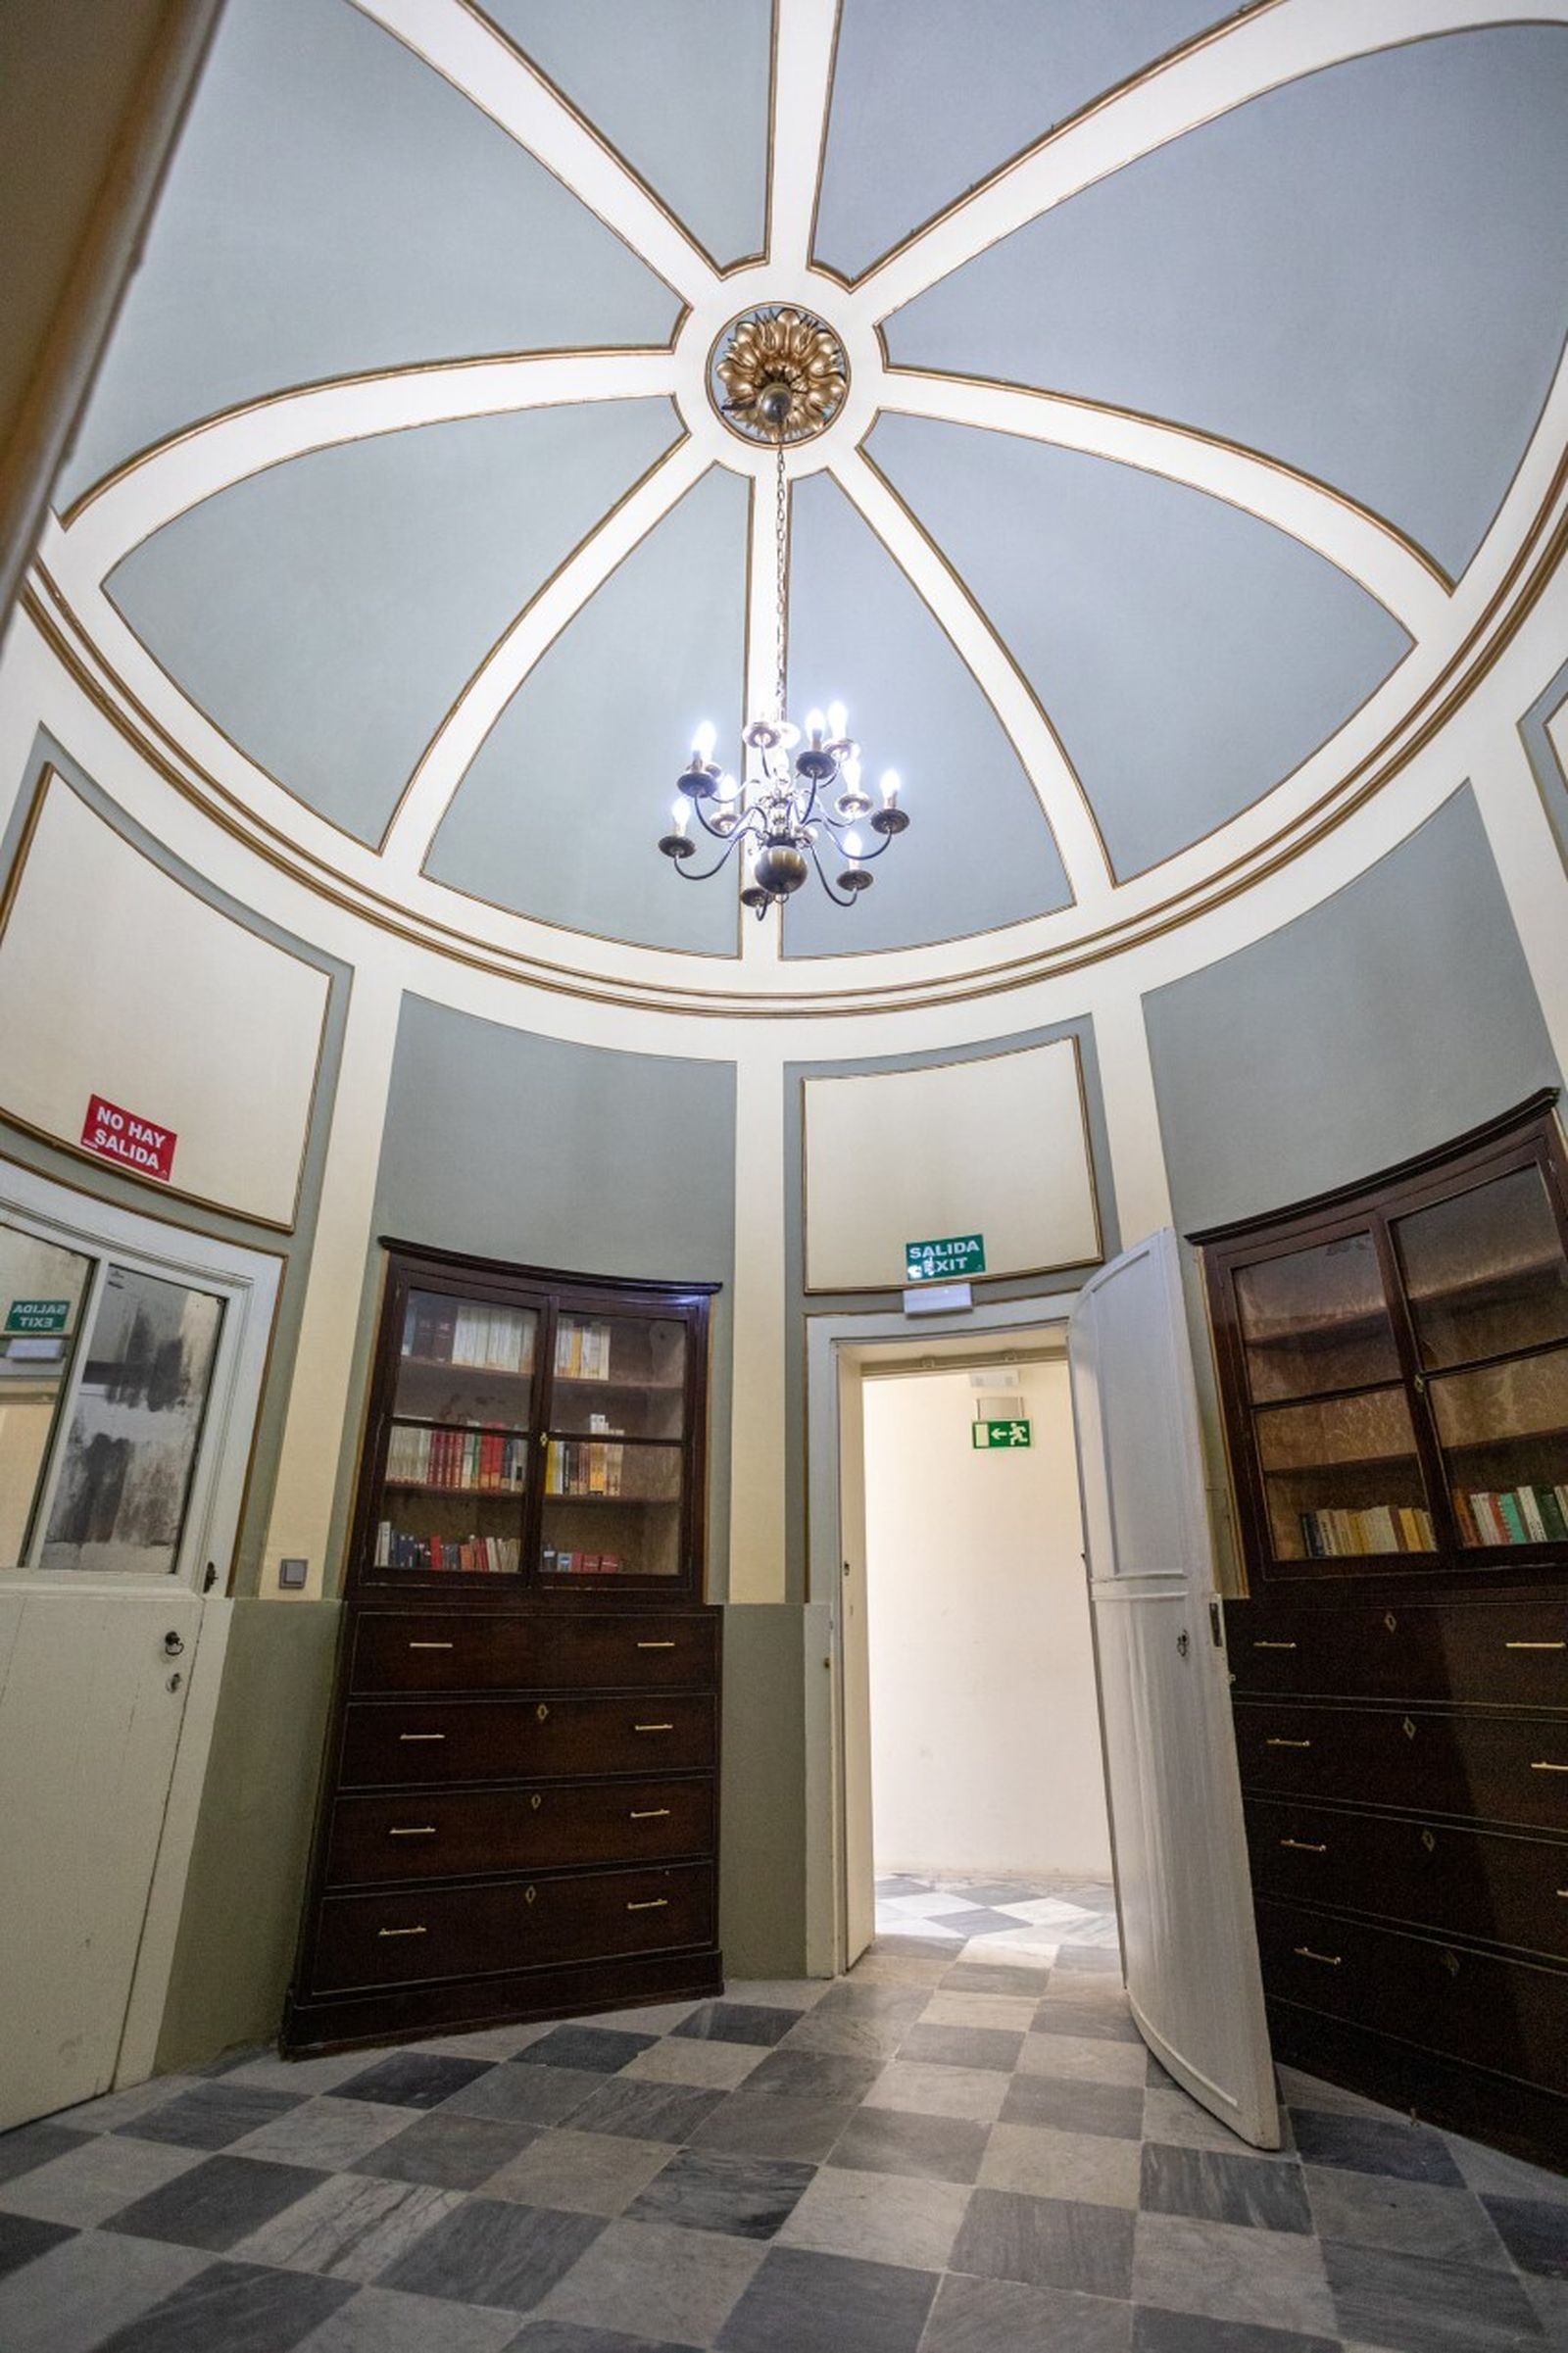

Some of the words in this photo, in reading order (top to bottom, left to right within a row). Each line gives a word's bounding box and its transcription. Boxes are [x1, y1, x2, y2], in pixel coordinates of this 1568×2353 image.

[97, 1106, 123, 1130] NO
[128, 1121, 166, 1149] HAY
[94, 1129, 159, 1169] SALIDA
[909, 1240, 980, 1259] SALIDA
[924, 1256, 968, 1273] EXIT
